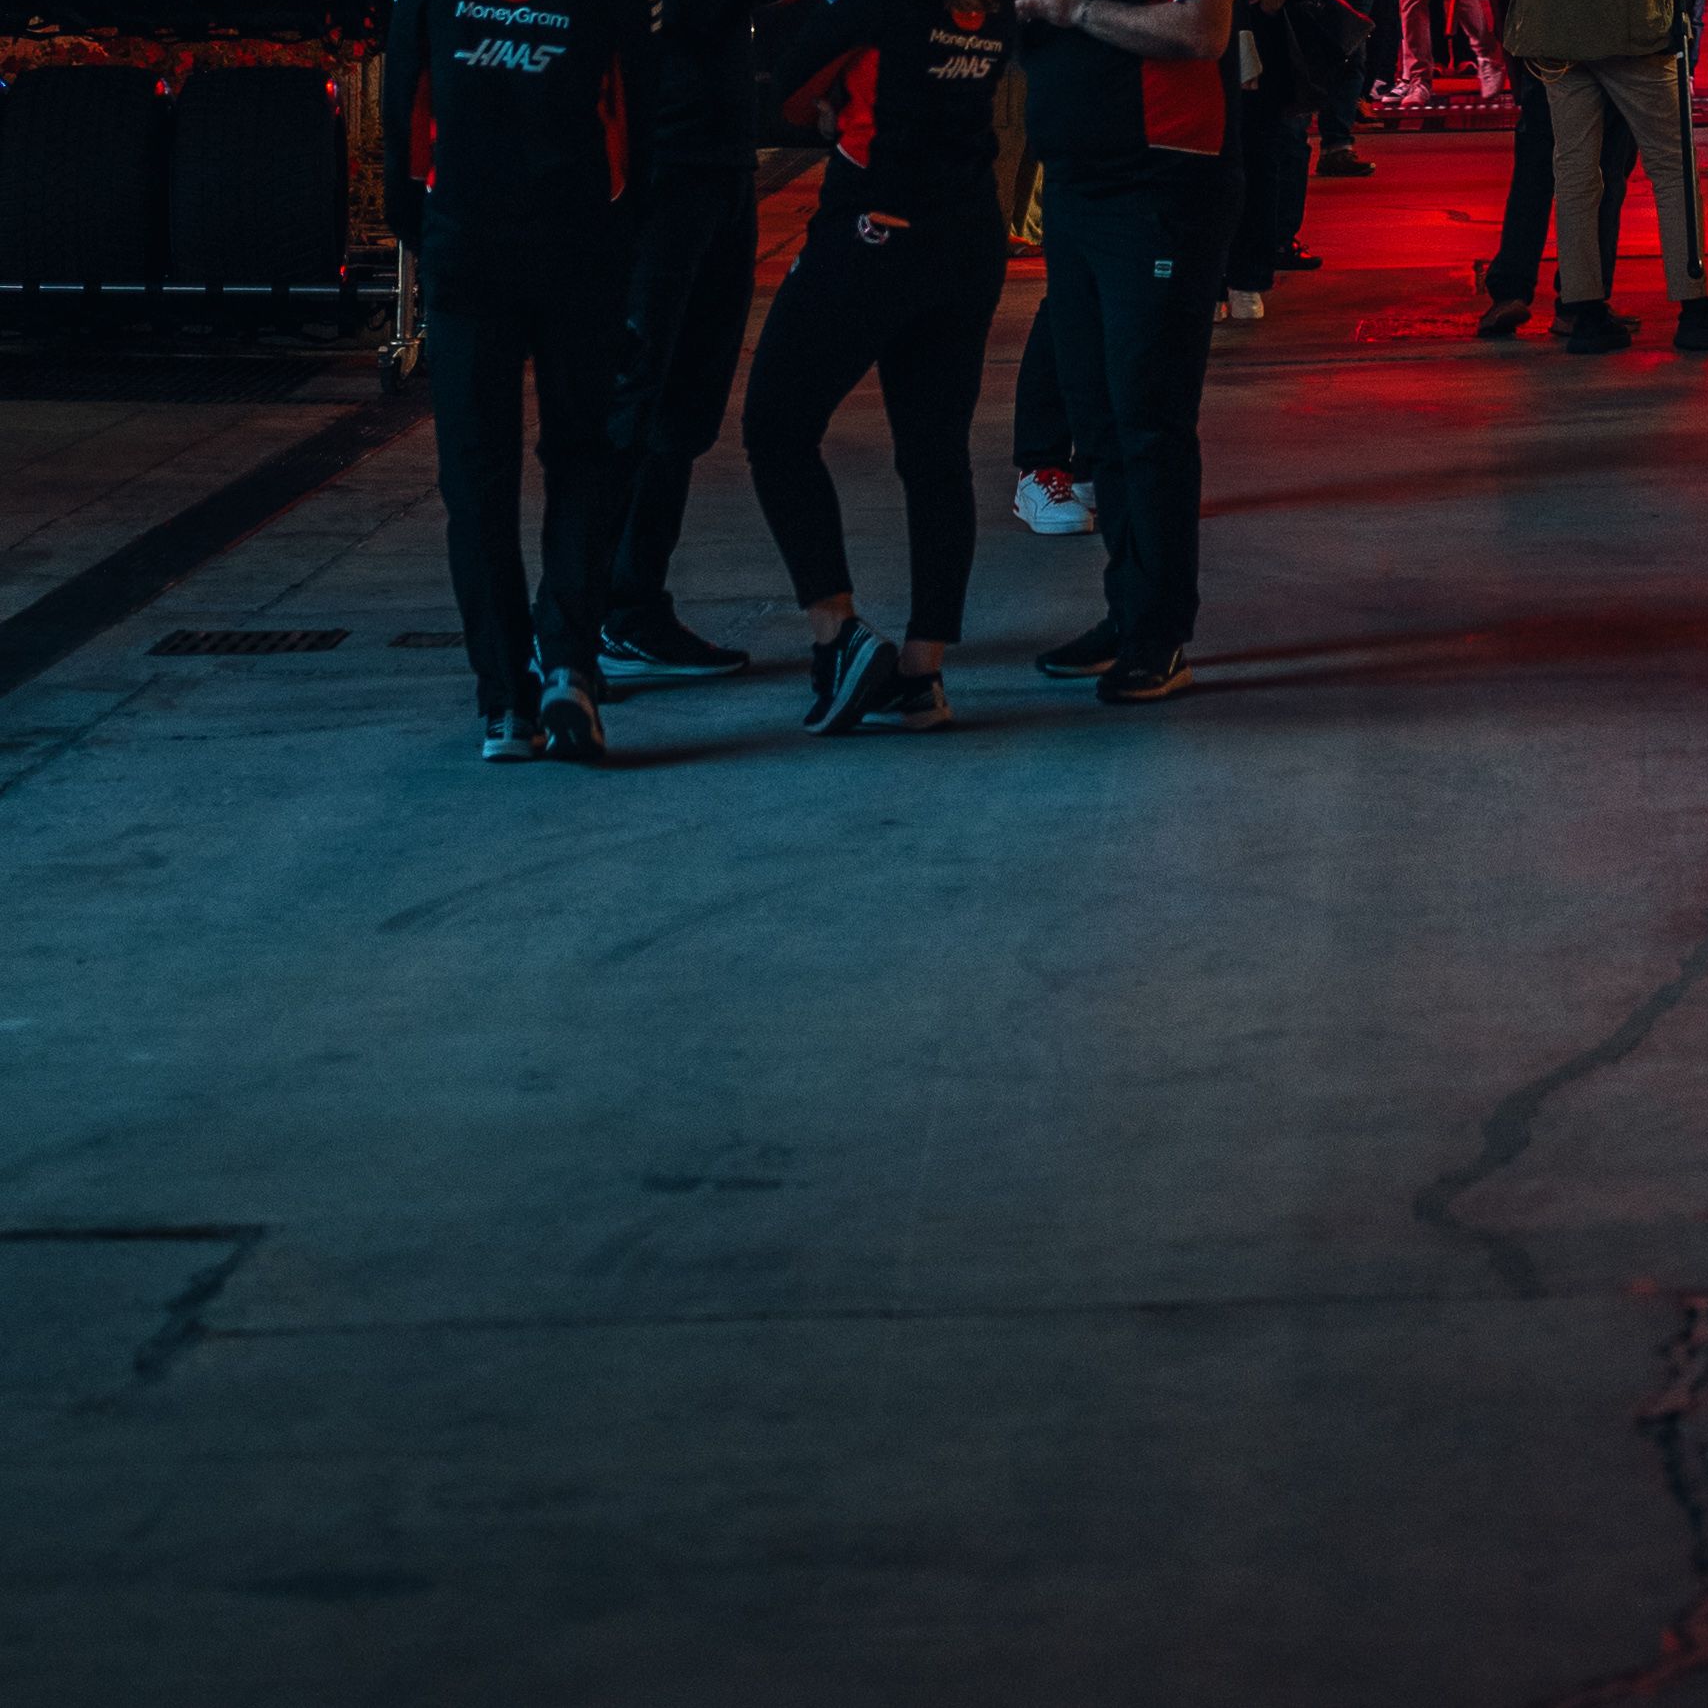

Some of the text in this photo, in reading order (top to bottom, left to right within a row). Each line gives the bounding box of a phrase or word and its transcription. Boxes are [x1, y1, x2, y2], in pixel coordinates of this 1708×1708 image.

[455, 0, 570, 29] MoneyGram
[929, 29, 1003, 53] MoneyGram
[454, 39, 568, 73] HAAS
